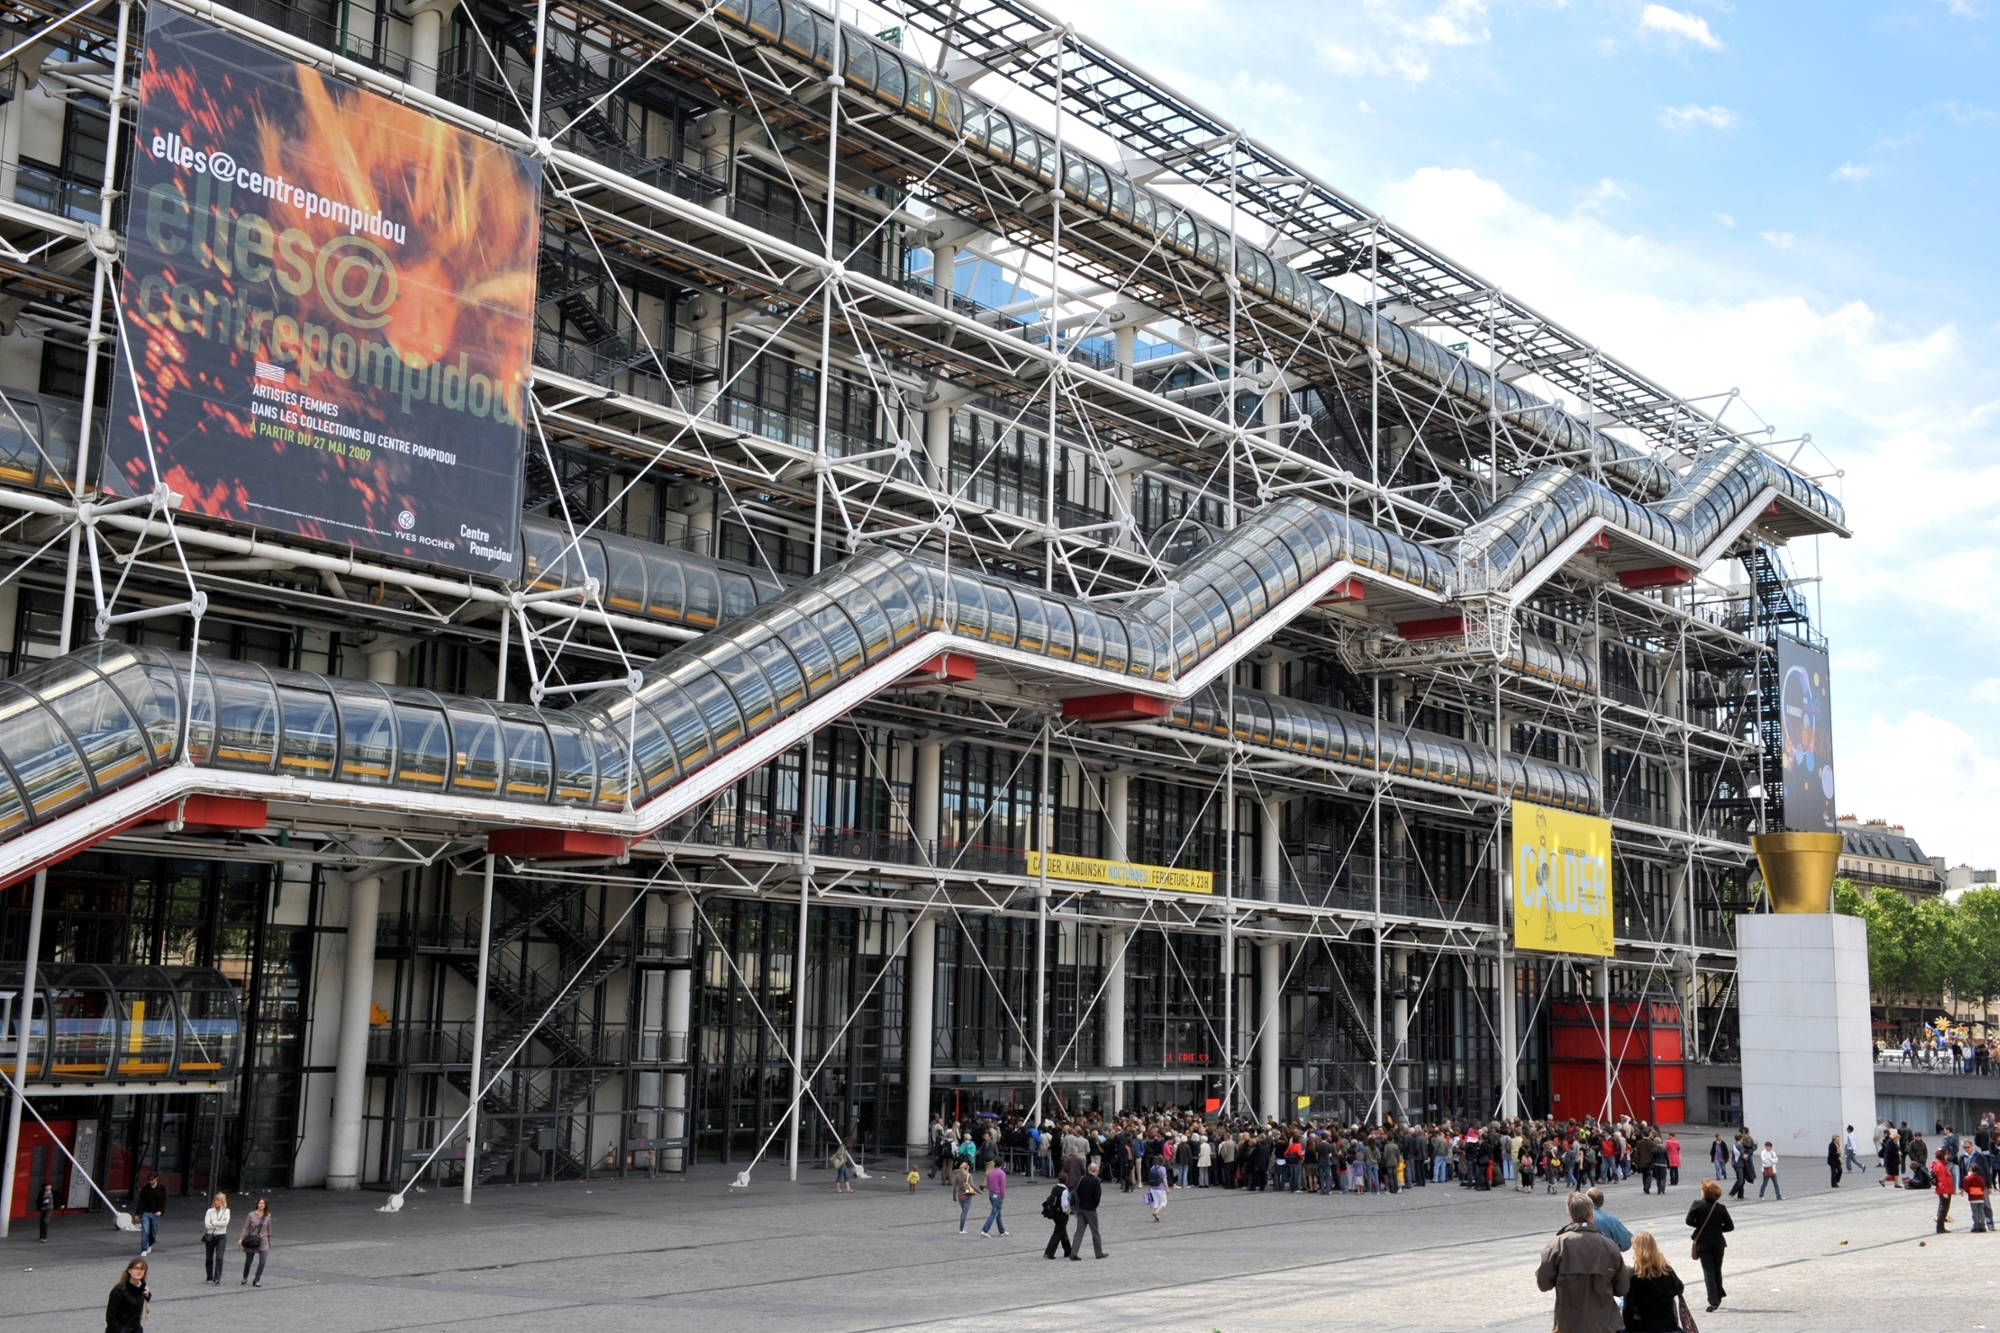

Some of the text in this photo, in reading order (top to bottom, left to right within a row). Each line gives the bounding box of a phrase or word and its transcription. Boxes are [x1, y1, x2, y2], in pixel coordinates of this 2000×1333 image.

[152, 132, 406, 245] elles@centrepompidou
[146, 170, 399, 329] elles@
[138, 274, 516, 427] centrepompidou
[252, 383, 339, 417] ARTISTES FEMMES
[249, 417, 372, 462] À PARTIR DU 27 MAI 2009
[251, 401, 457, 466] DANS LES COLLECTIONS DU CENTRE POMPIDOU
[394, 530, 456, 551] YVES ROCHER
[460, 523, 490, 543] Centre
[469, 541, 513, 563] Pompidou
[1032, 856, 1064, 875] CADER,
[1065, 860, 1107, 878] KANDINSKY
[1151, 870, 1189, 888] FERMETURE
[1520, 843, 1608, 918] CALDER
